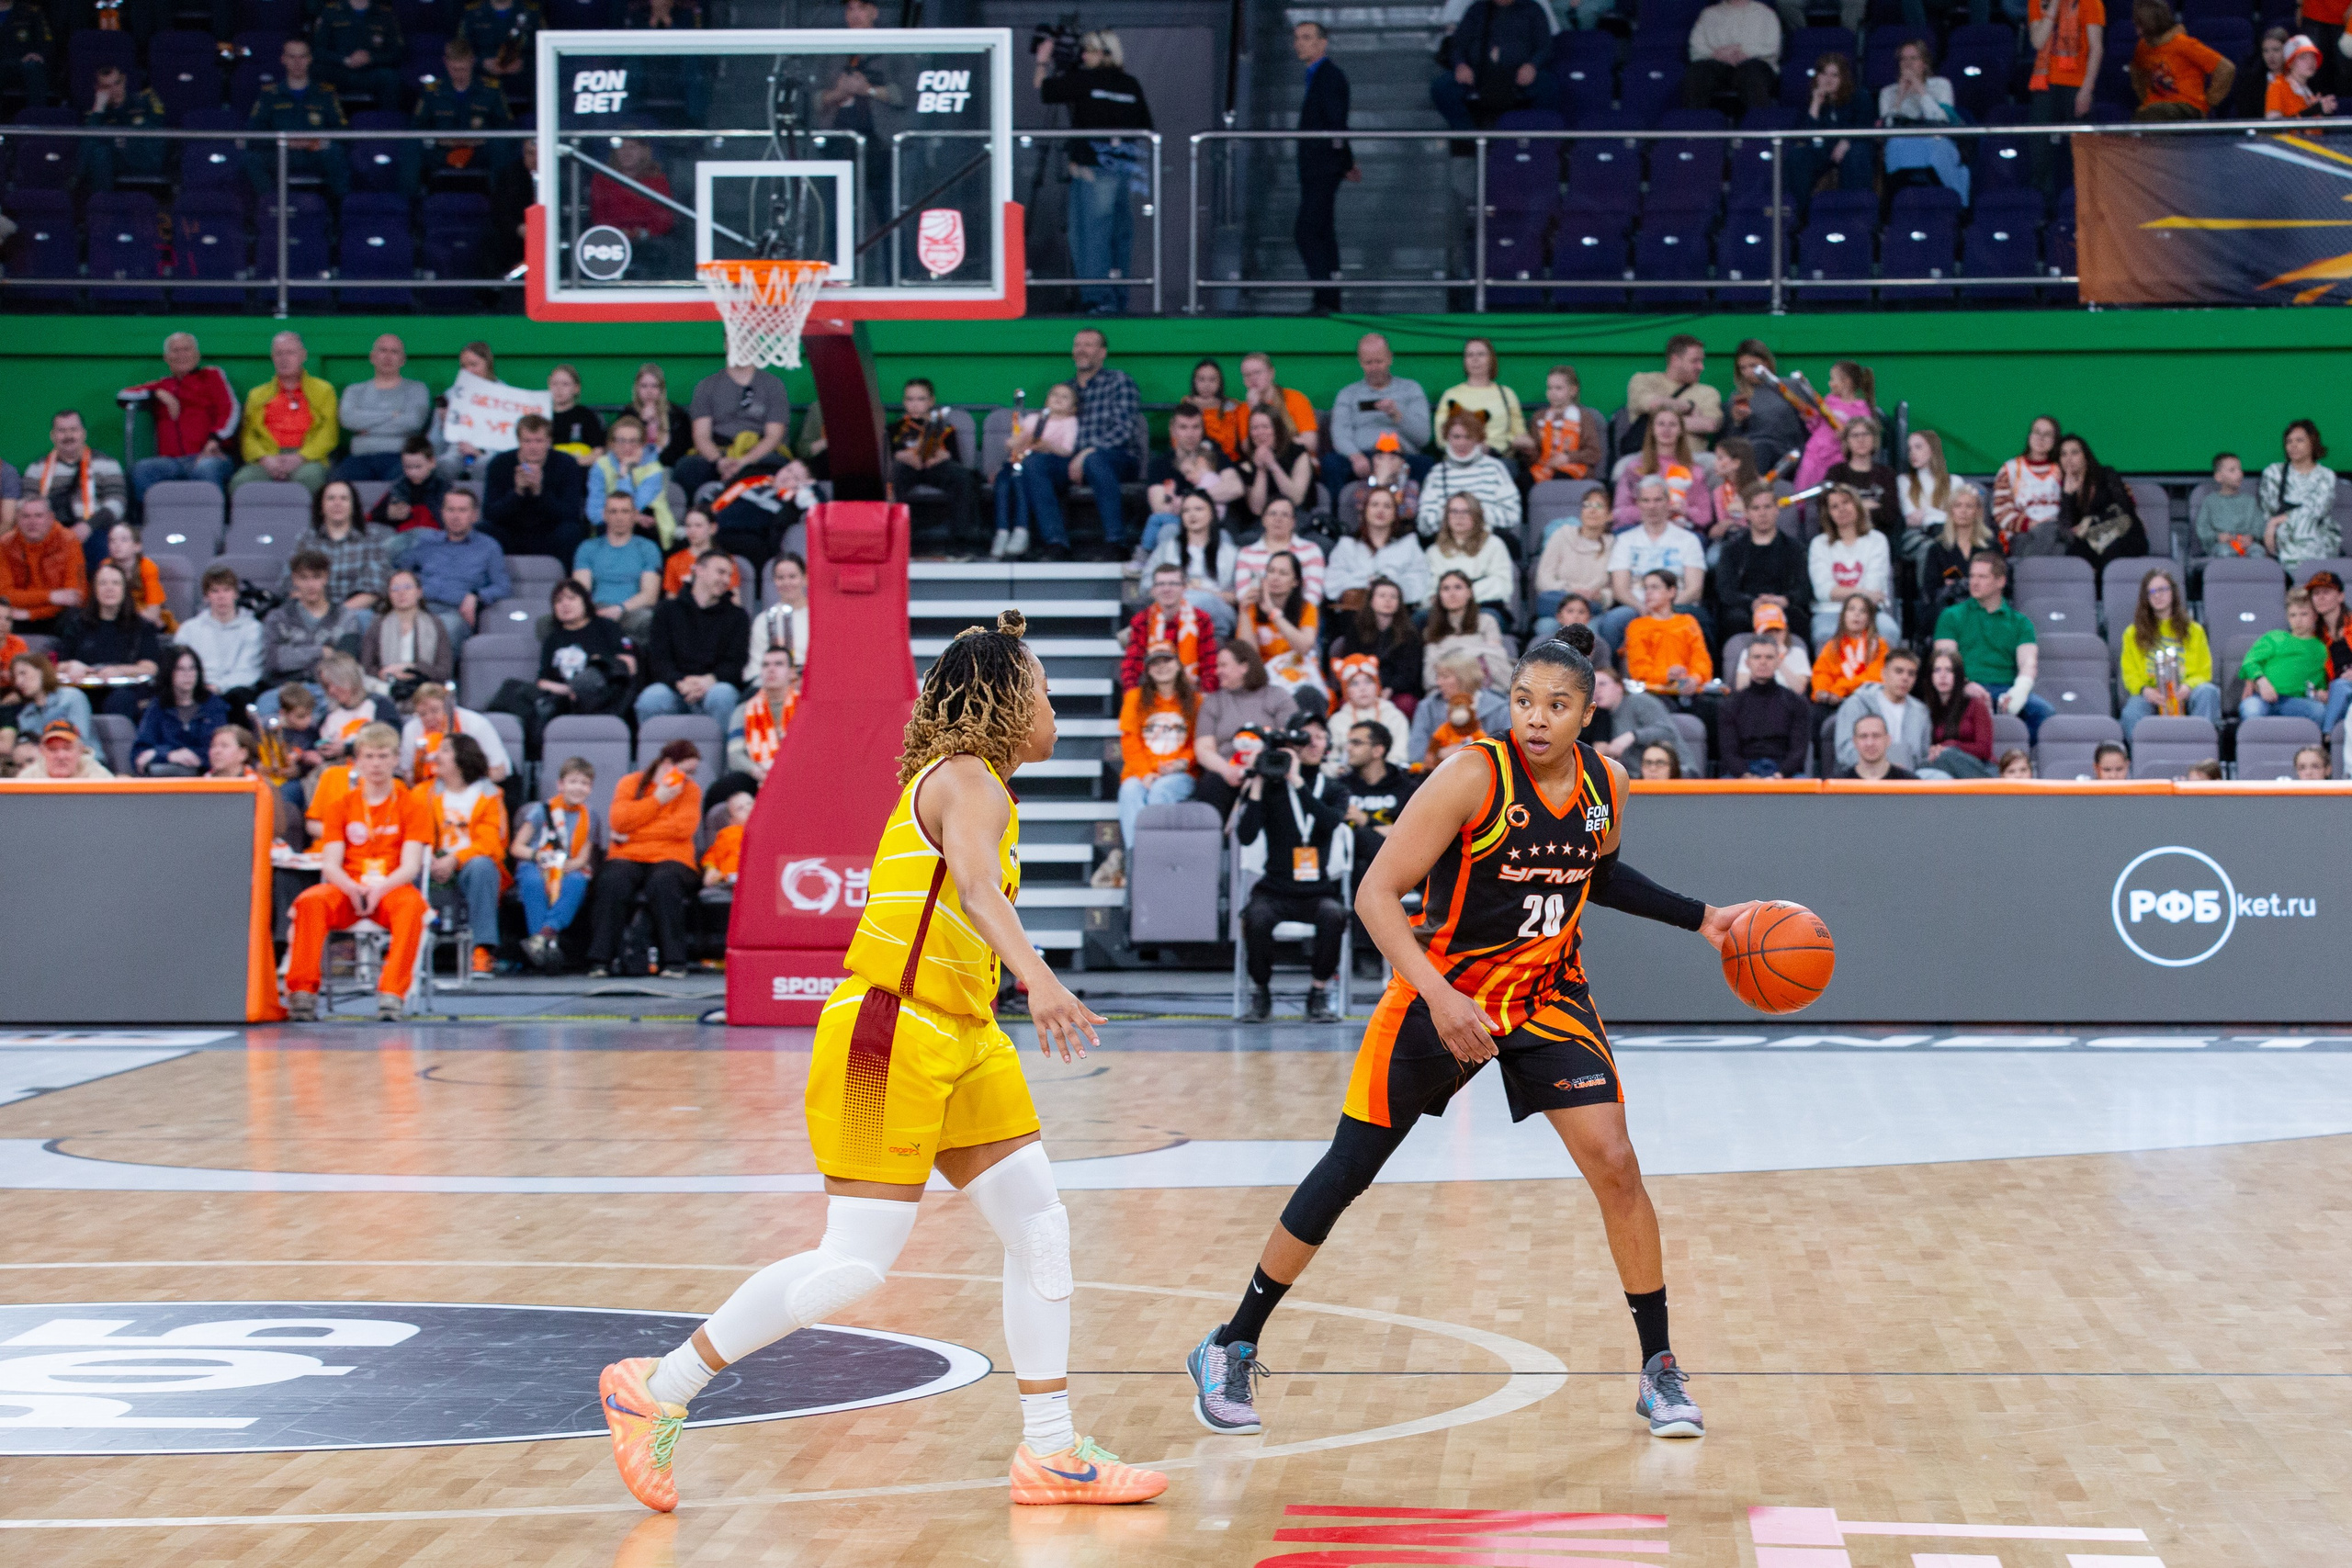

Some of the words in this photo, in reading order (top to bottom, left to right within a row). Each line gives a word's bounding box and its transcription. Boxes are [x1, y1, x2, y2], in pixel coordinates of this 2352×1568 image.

[573, 70, 628, 92] FON
[917, 70, 970, 92] FON
[573, 91, 628, 114] BET
[917, 92, 971, 113] BET
[582, 243, 625, 261] РФБ
[1587, 805, 1609, 818] FON
[1585, 818, 1607, 832] BET
[1518, 894, 1565, 938] 20
[2129, 889, 2222, 924] РФБ
[1606, 1033, 2352, 1049] ONBET
